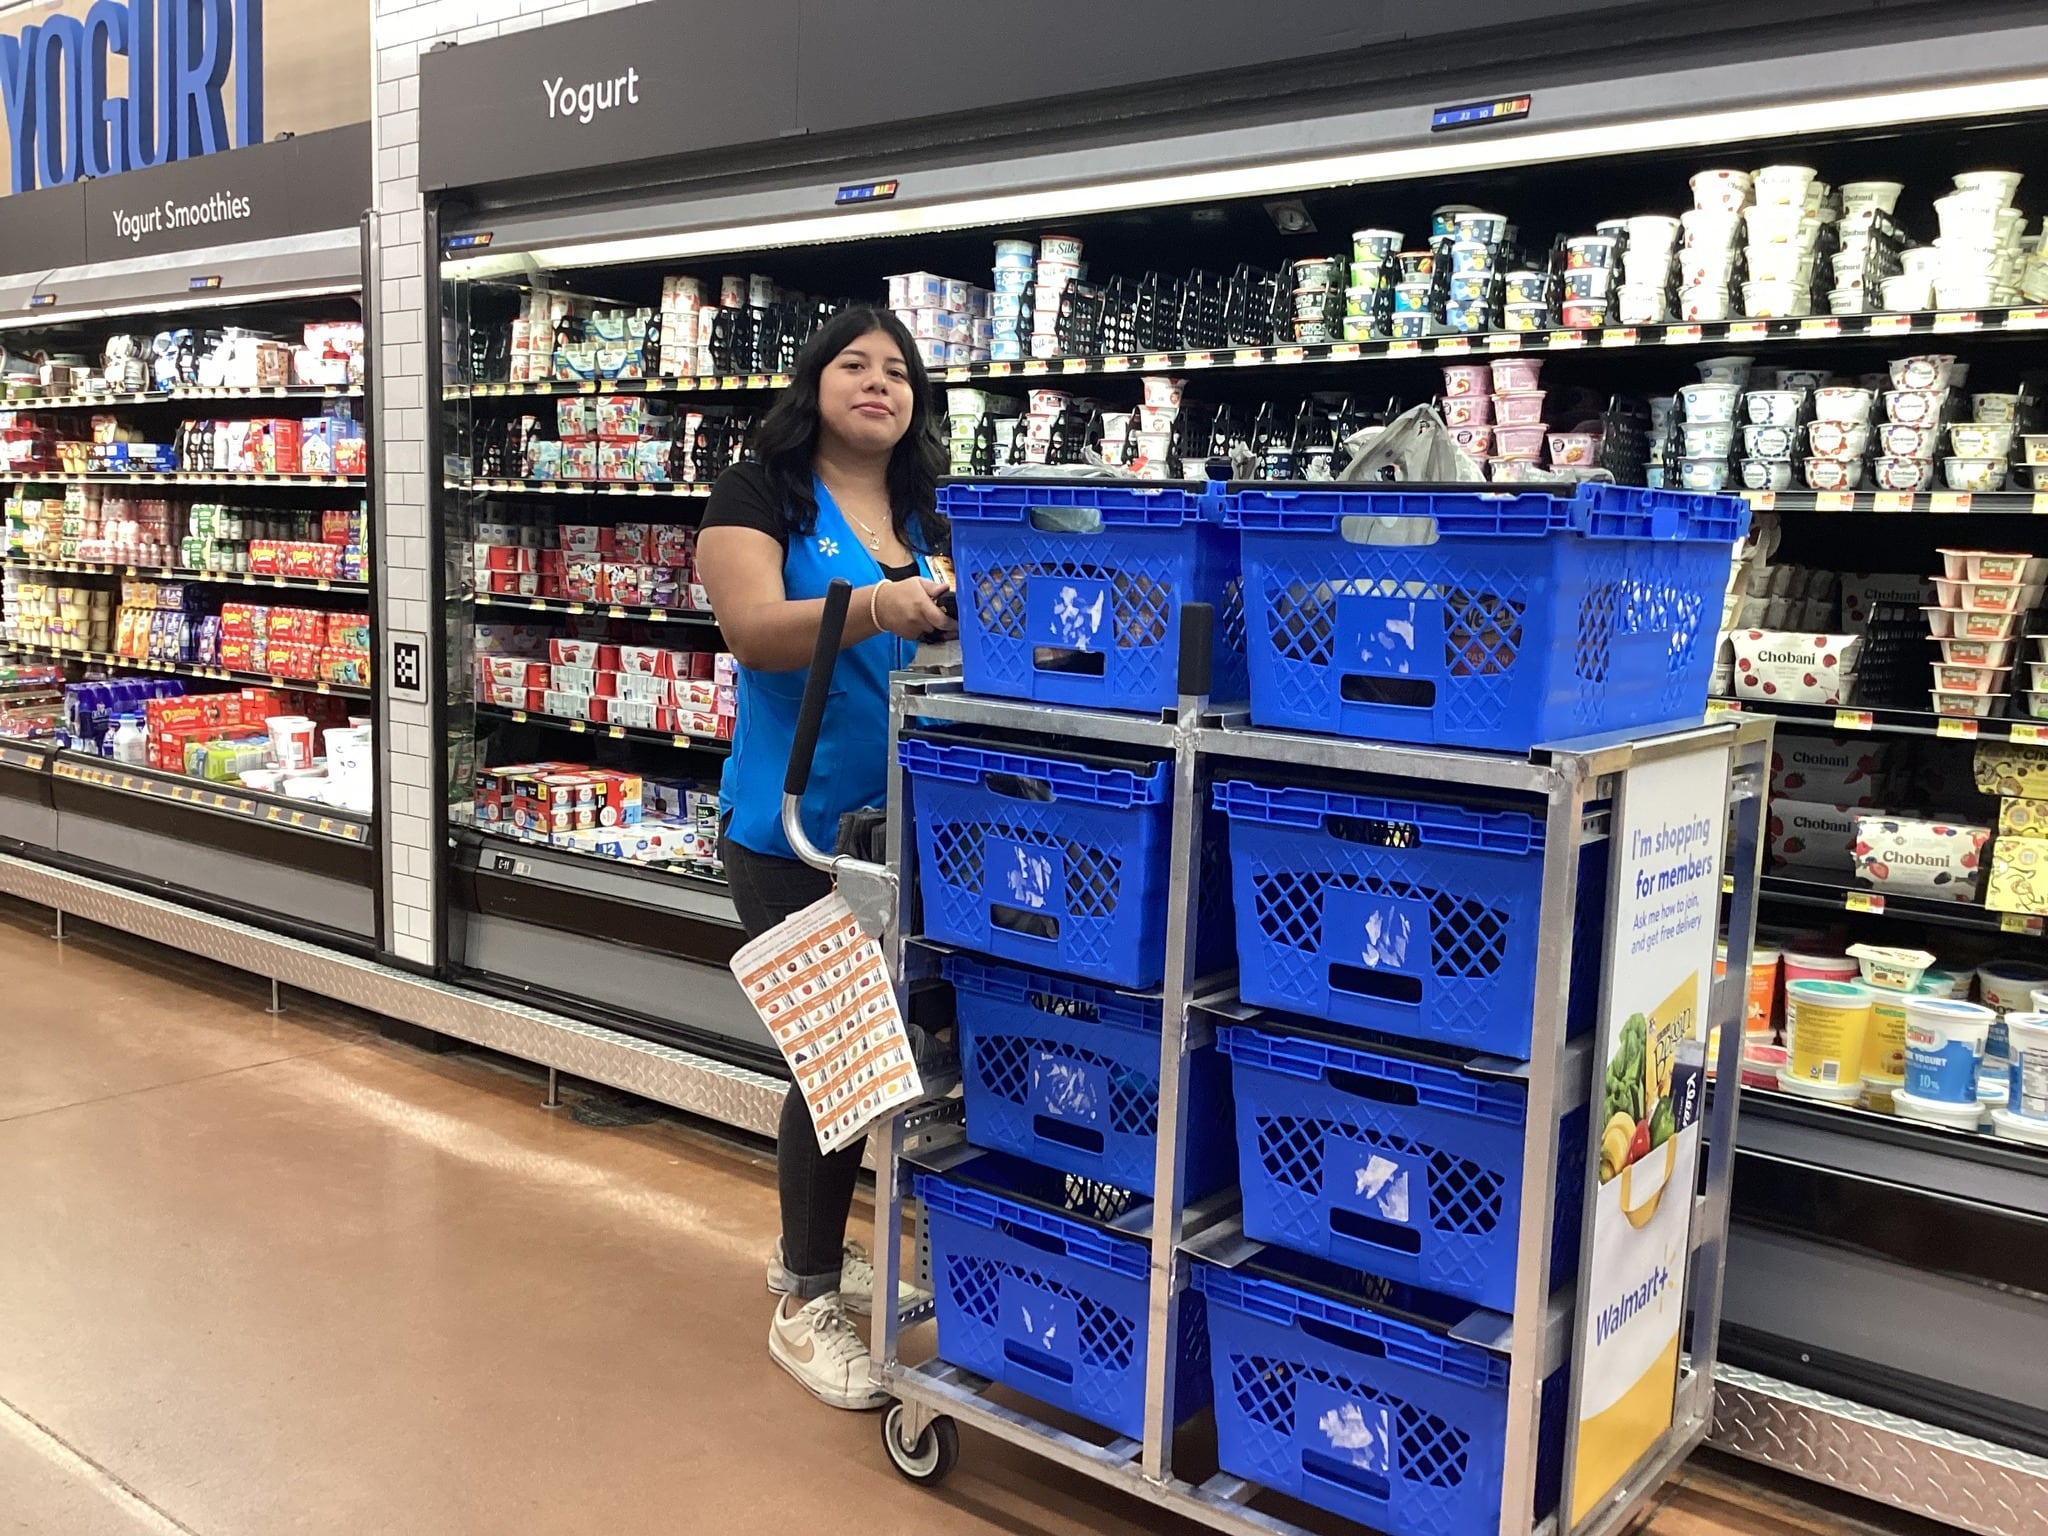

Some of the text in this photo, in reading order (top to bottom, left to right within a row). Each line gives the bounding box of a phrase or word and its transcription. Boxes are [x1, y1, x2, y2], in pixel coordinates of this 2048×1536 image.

[543, 67, 639, 124] Yogurt
[112, 190, 251, 242] Yogurt Smoothies
[1056, 242, 1077, 255] Silk
[1758, 650, 1816, 665] Chobani
[1793, 751, 1849, 768] Chobani
[1632, 814, 1710, 860] I'm shopping
[1793, 816, 1851, 833] Chobani
[601, 842, 616, 855] 12
[1883, 851, 1950, 868] Chobani
[1636, 853, 1713, 900] for members
[1633, 910, 1646, 930] Ask
[1648, 910, 1660, 924] me
[1661, 902, 1675, 921] how
[1676, 897, 1684, 912] to
[1631, 914, 1702, 954] and get free delivery
[1914, 1053, 1948, 1067] YOGURT
[1596, 1265, 1668, 1347] Walmart+
